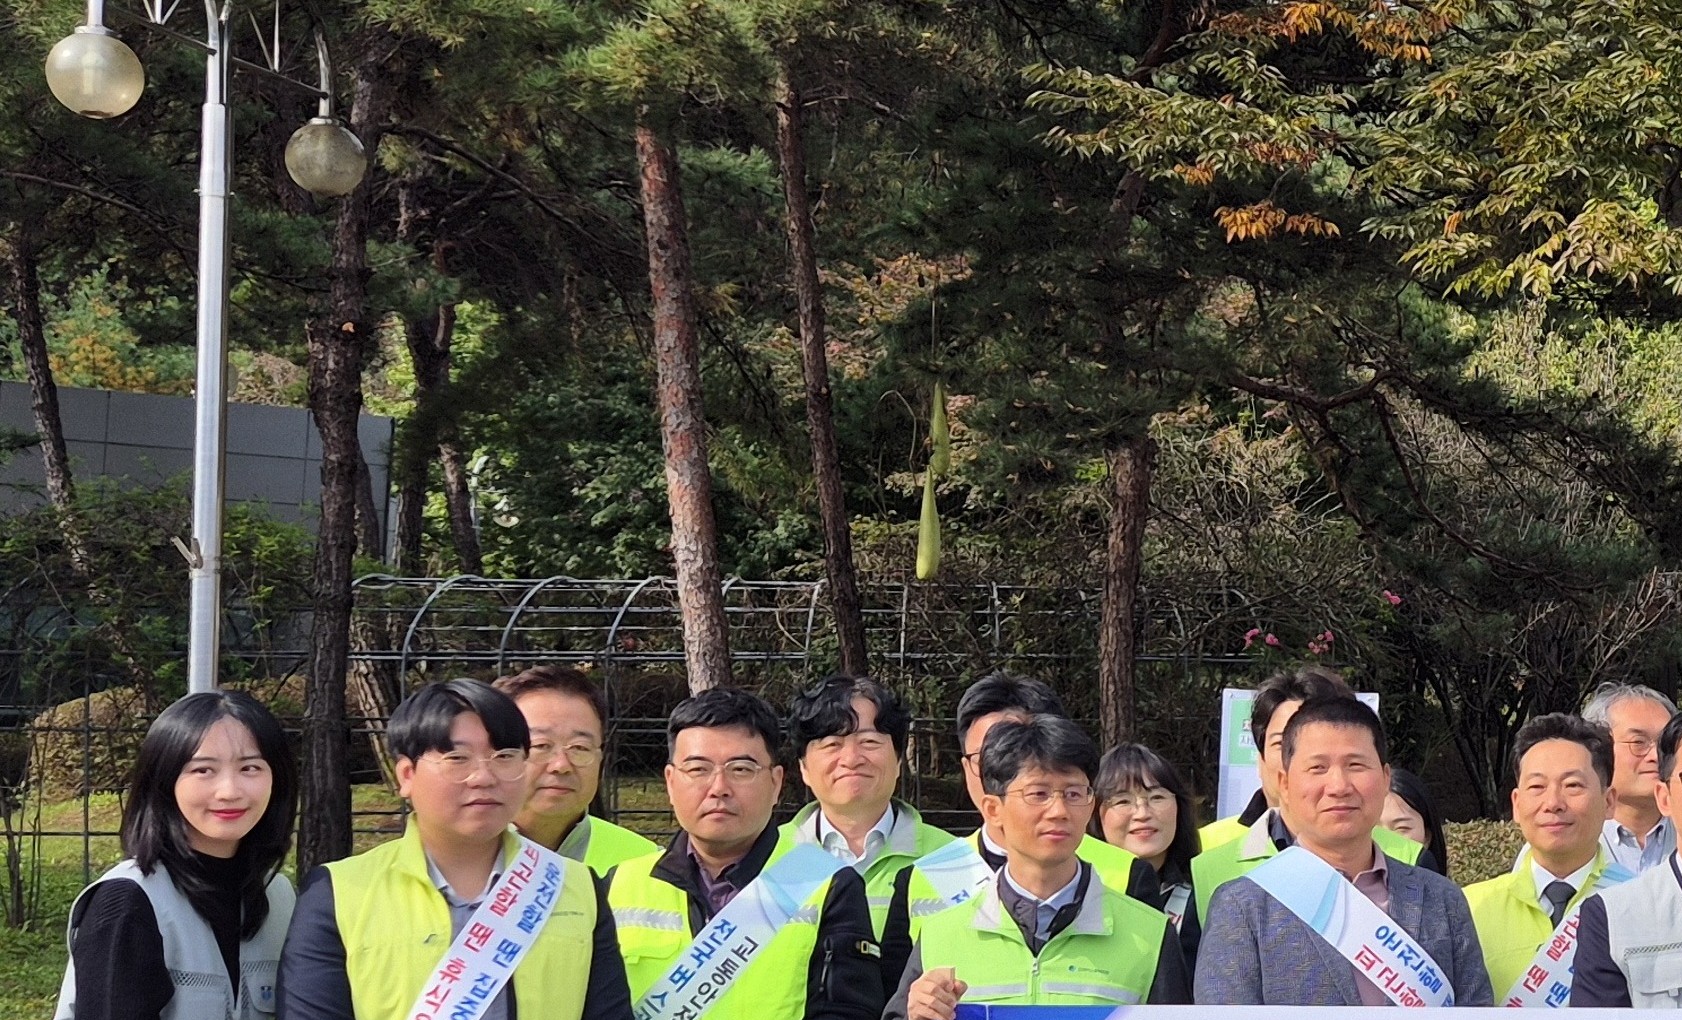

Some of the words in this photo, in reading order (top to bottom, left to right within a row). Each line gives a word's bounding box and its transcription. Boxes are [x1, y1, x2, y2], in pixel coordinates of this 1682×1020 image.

[517, 862, 561, 934] 운전할
[464, 922, 495, 952] 땐
[492, 938, 522, 968] 땐
[1375, 925, 1443, 994] 운전할
